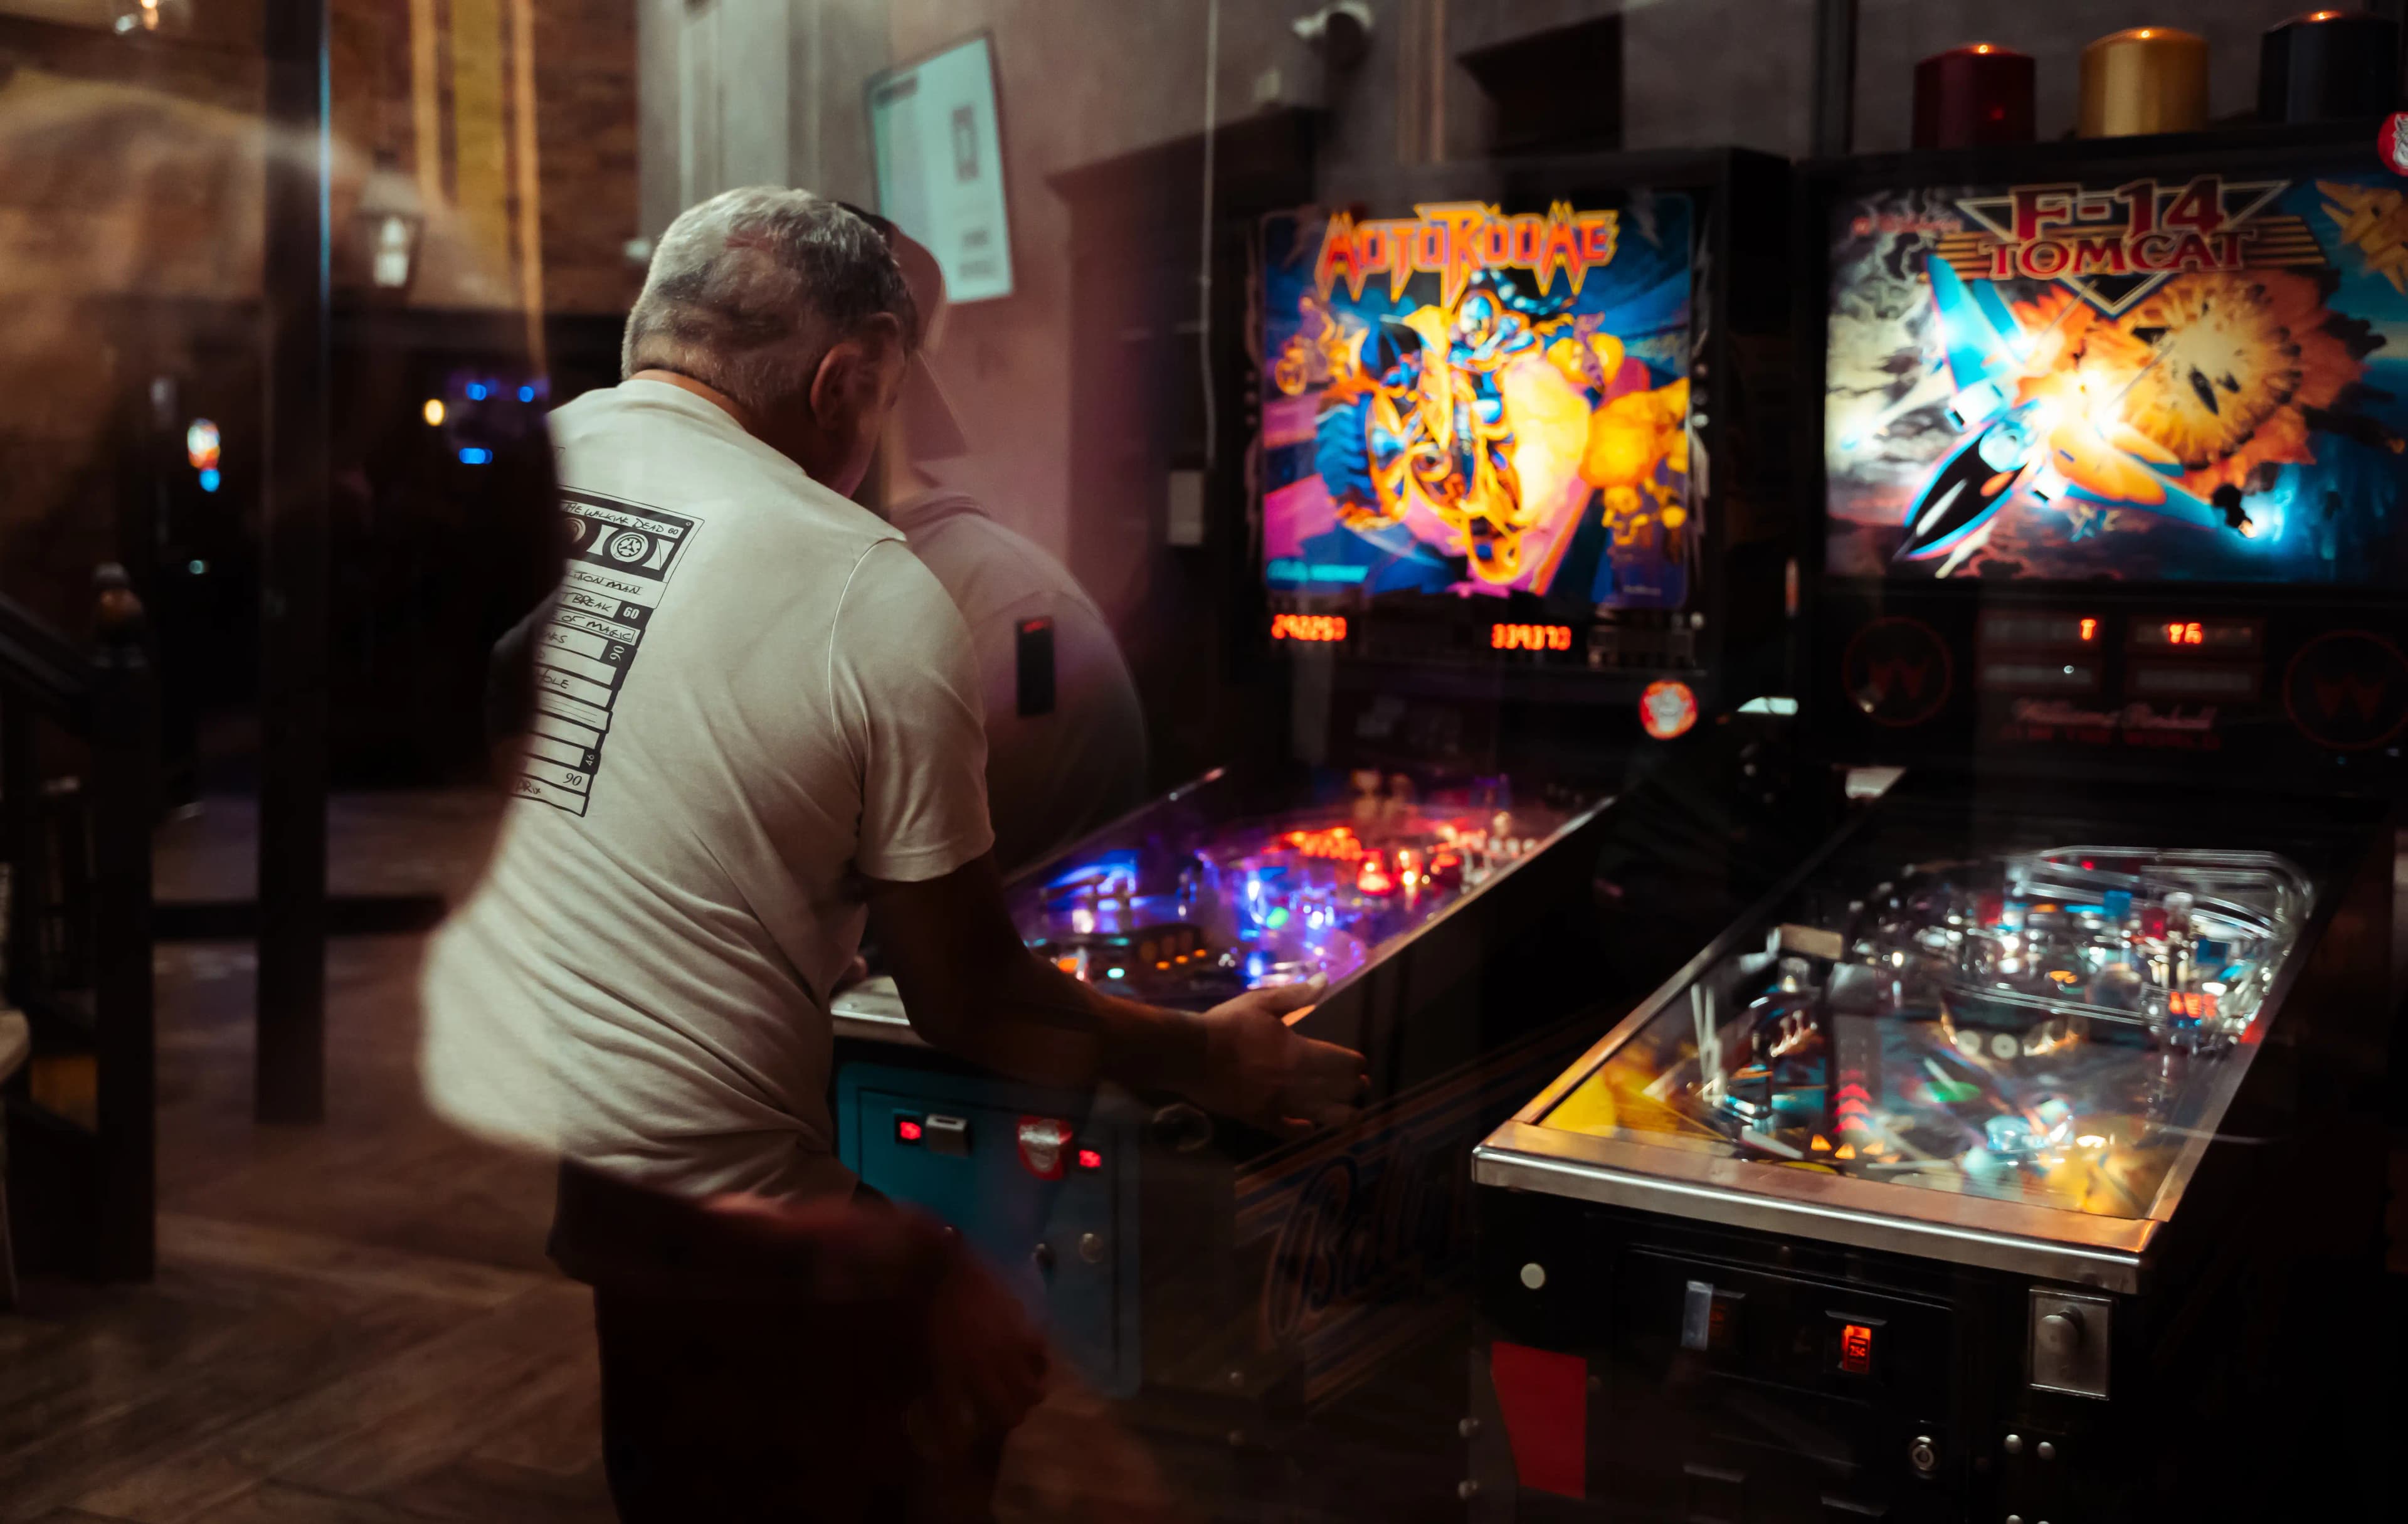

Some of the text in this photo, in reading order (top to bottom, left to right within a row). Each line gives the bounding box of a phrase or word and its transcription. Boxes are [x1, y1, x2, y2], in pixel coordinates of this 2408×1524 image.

[2009, 174, 2226, 240] F-14
[1978, 229, 2256, 280] TOMCAT
[632, 518, 663, 532] DEAD
[606, 582, 640, 595] MAN
[623, 606, 640, 620] 60
[586, 622, 631, 640] MAGIC
[610, 645, 625, 661] 90
[562, 773, 583, 786] 90
